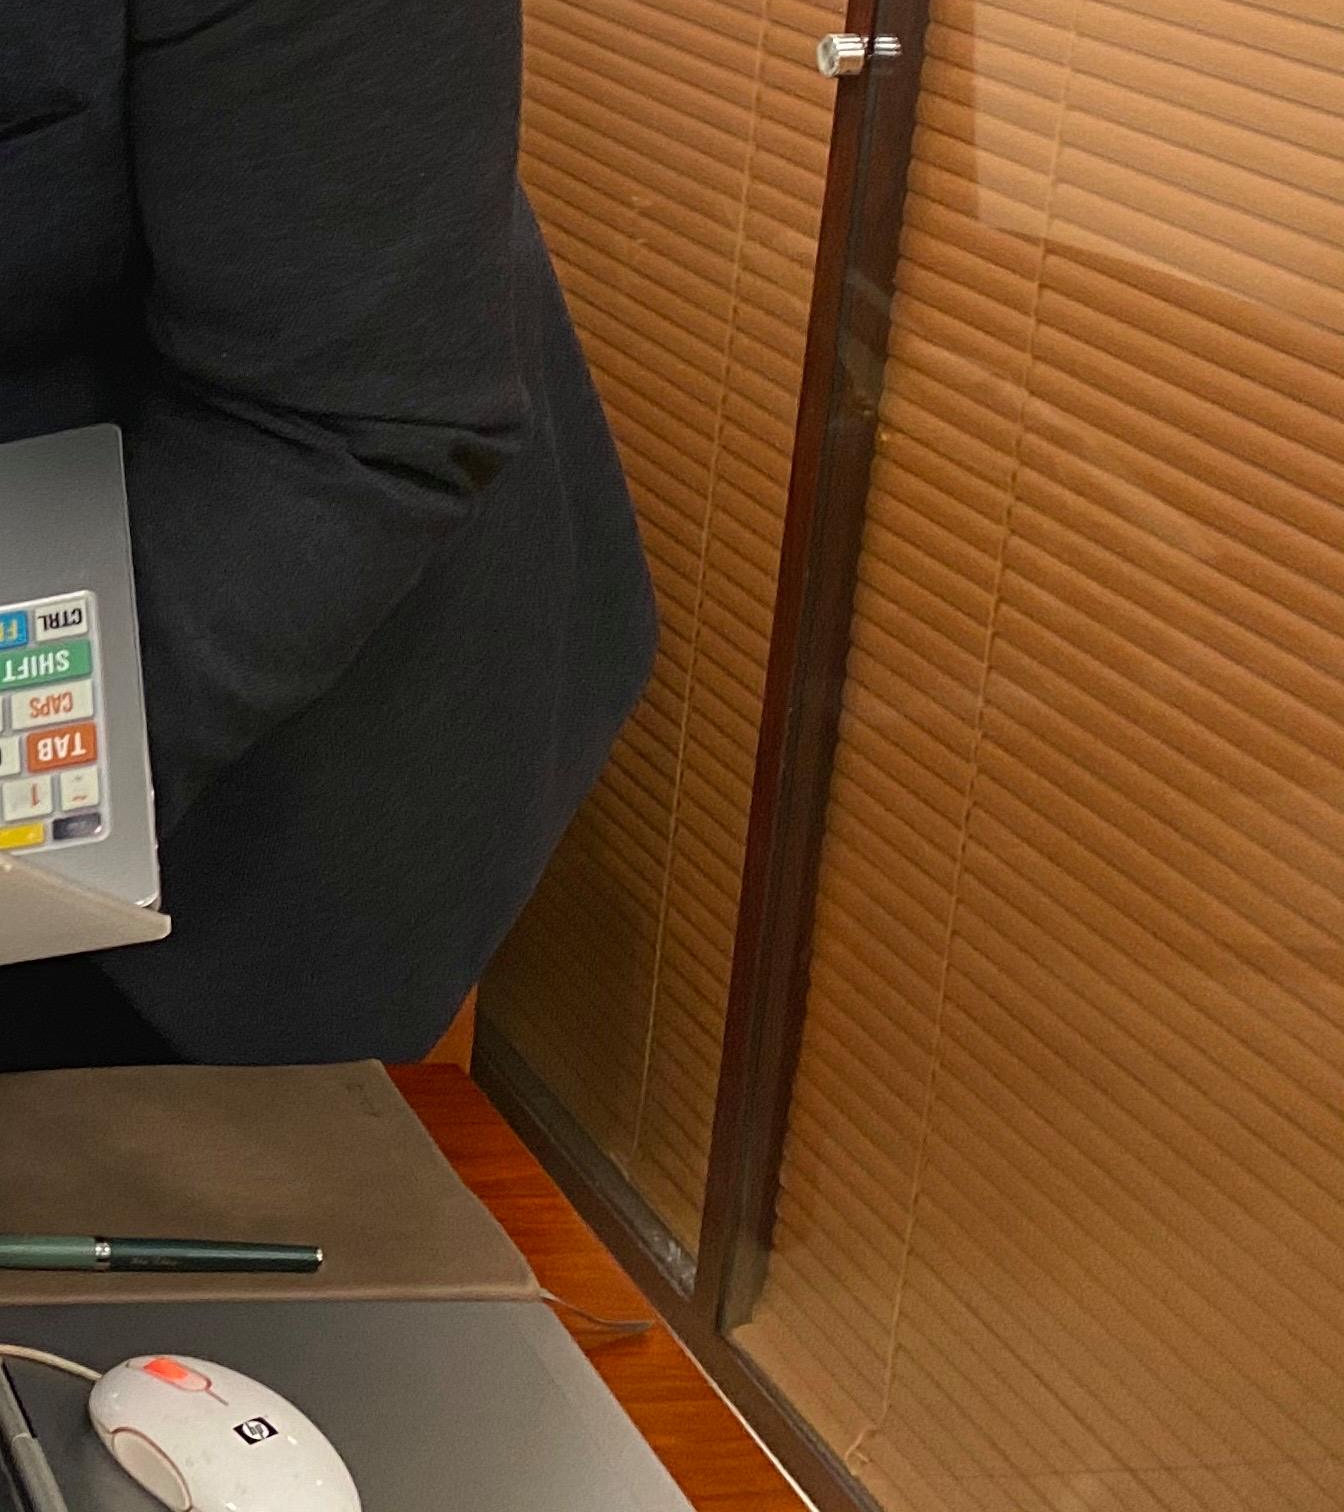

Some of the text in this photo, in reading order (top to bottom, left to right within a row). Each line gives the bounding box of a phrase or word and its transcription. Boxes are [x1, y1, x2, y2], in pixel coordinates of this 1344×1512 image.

[39, 608, 82, 630] CTRL
[3, 650, 69, 680] SHIFT
[30, 693, 73, 718] CAPS
[38, 733, 85, 760] TAB
